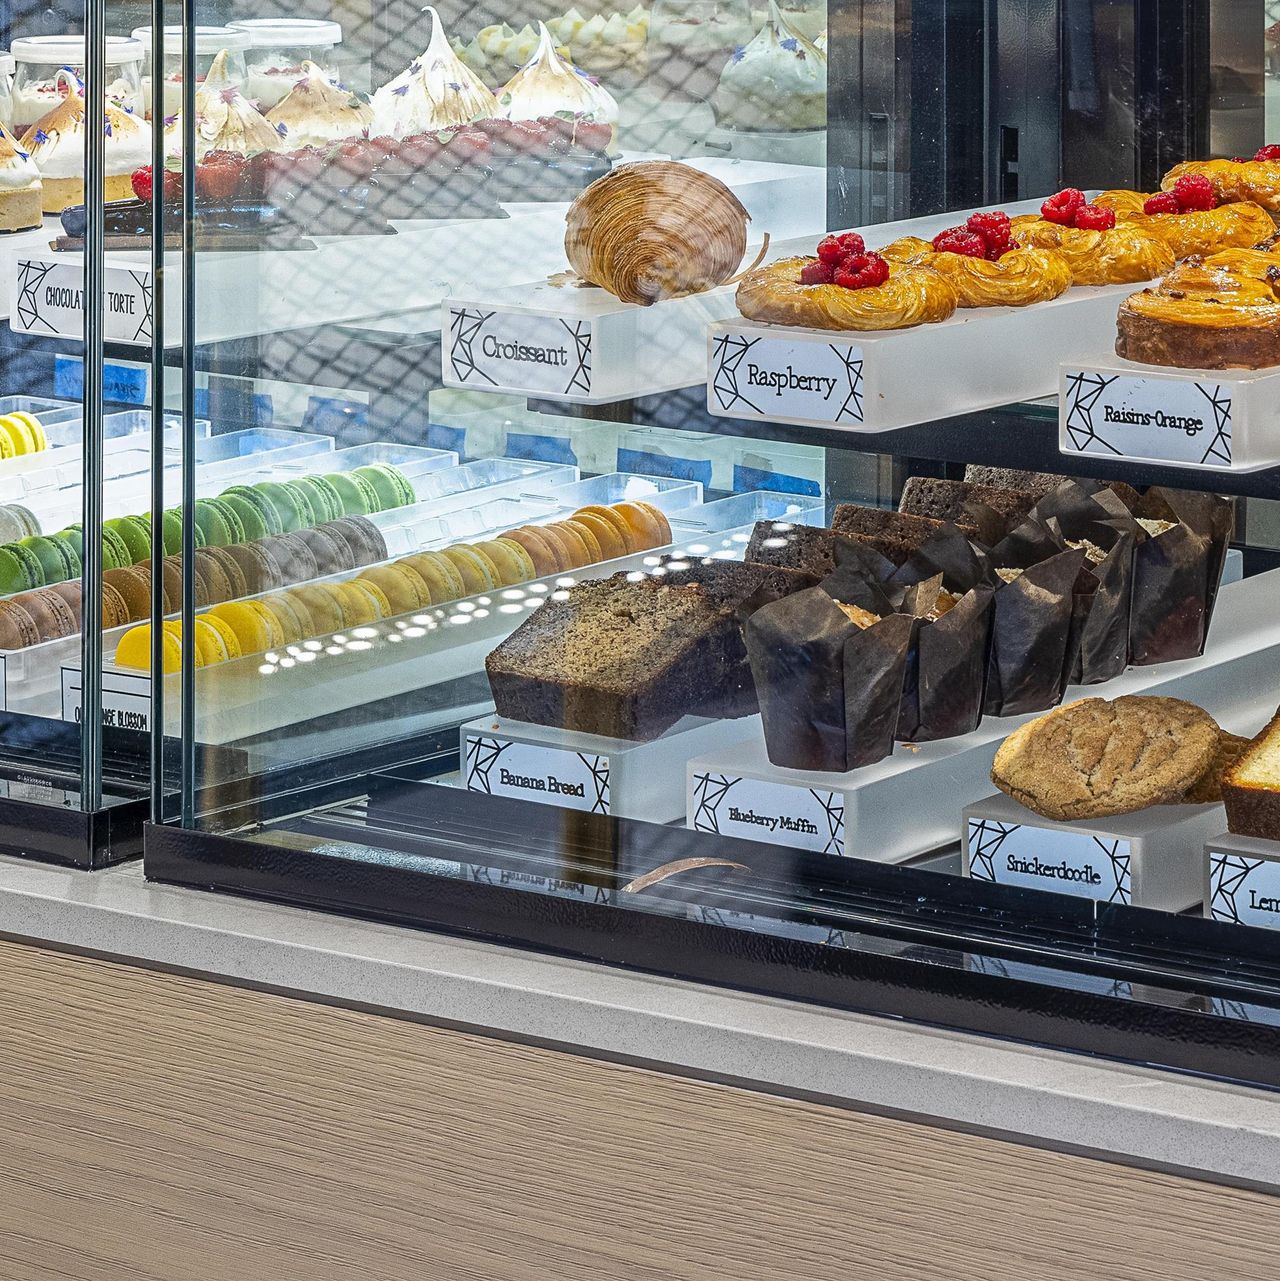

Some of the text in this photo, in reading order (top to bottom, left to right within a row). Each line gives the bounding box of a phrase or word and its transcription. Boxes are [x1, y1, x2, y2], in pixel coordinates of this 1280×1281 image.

[108, 292, 135, 314] TORTE
[482, 334, 568, 367] Croissant
[747, 363, 838, 401] Raspberry
[1102, 403, 1204, 436] Raisins-Orange
[117, 710, 147, 731] BLOSSOM
[499, 768, 585, 799] Banana Bread
[728, 807, 819, 835] Blueberry Muffin
[1006, 854, 1102, 885] Snickerdoodle
